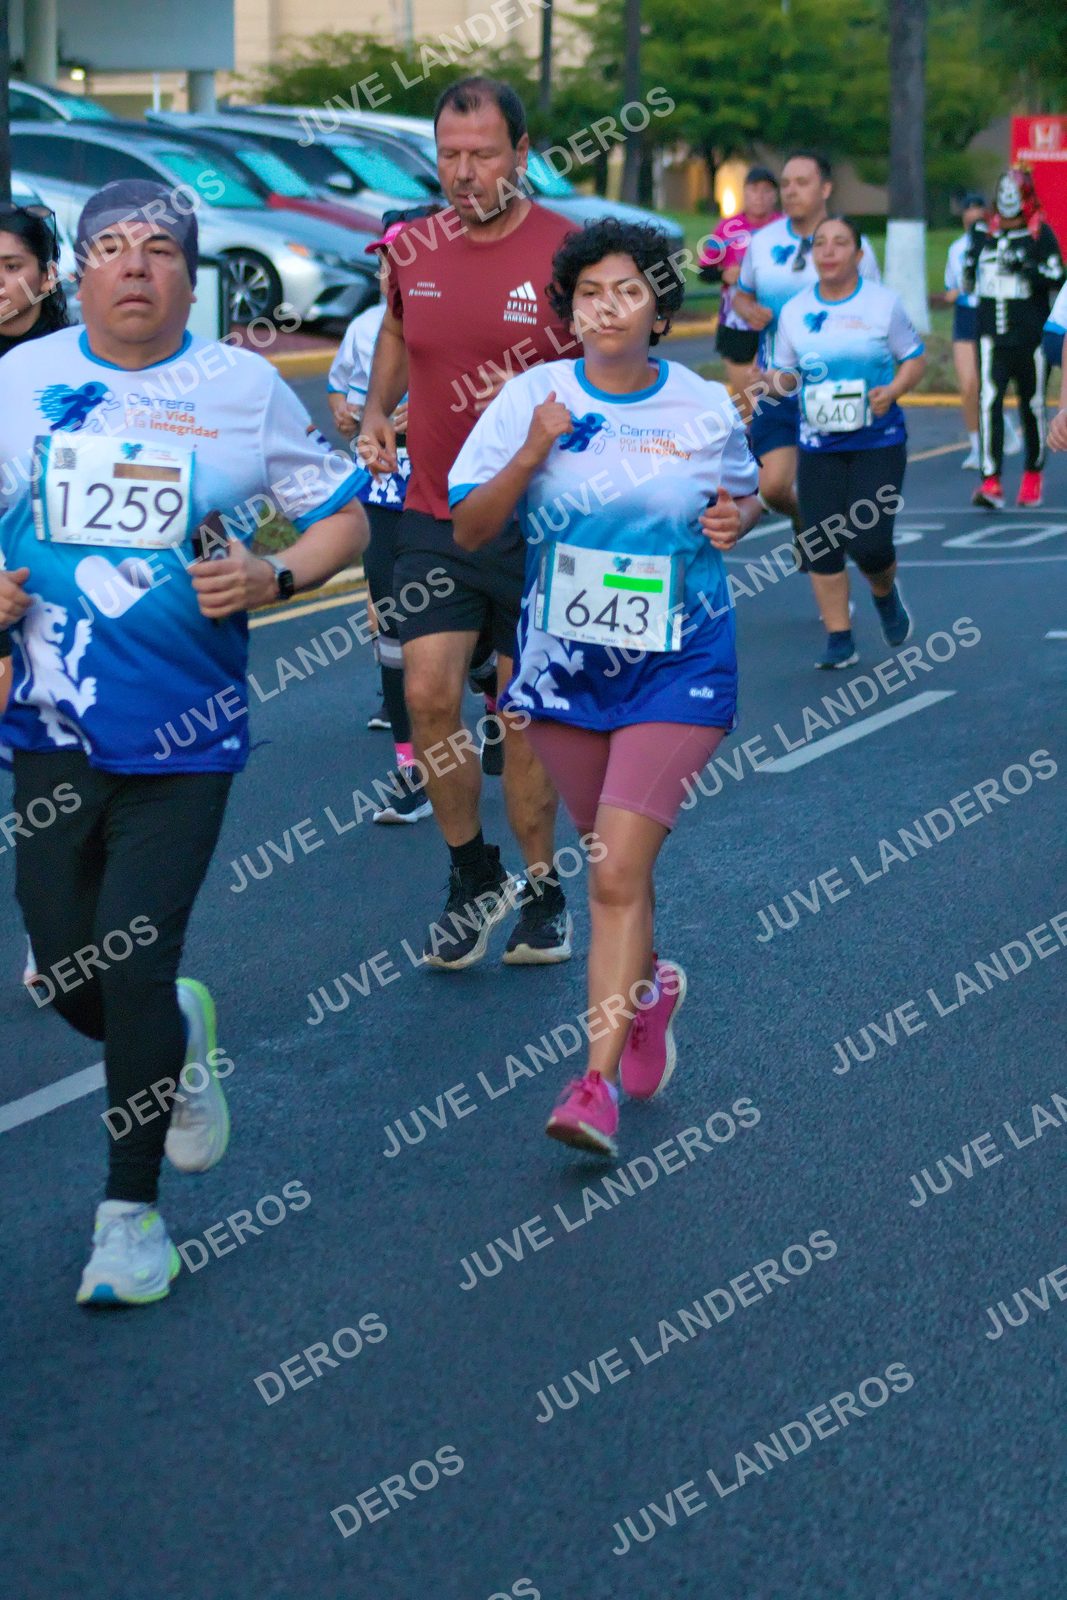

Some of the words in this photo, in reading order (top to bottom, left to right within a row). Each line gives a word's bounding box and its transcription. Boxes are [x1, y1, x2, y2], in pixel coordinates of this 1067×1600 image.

[127, 393, 195, 411] Carrera
[166, 411, 195, 423] Vida
[816, 403, 857, 425] 640
[150, 419, 218, 438] Integridad
[56, 482, 183, 533] 1259
[565, 589, 650, 635] 643
